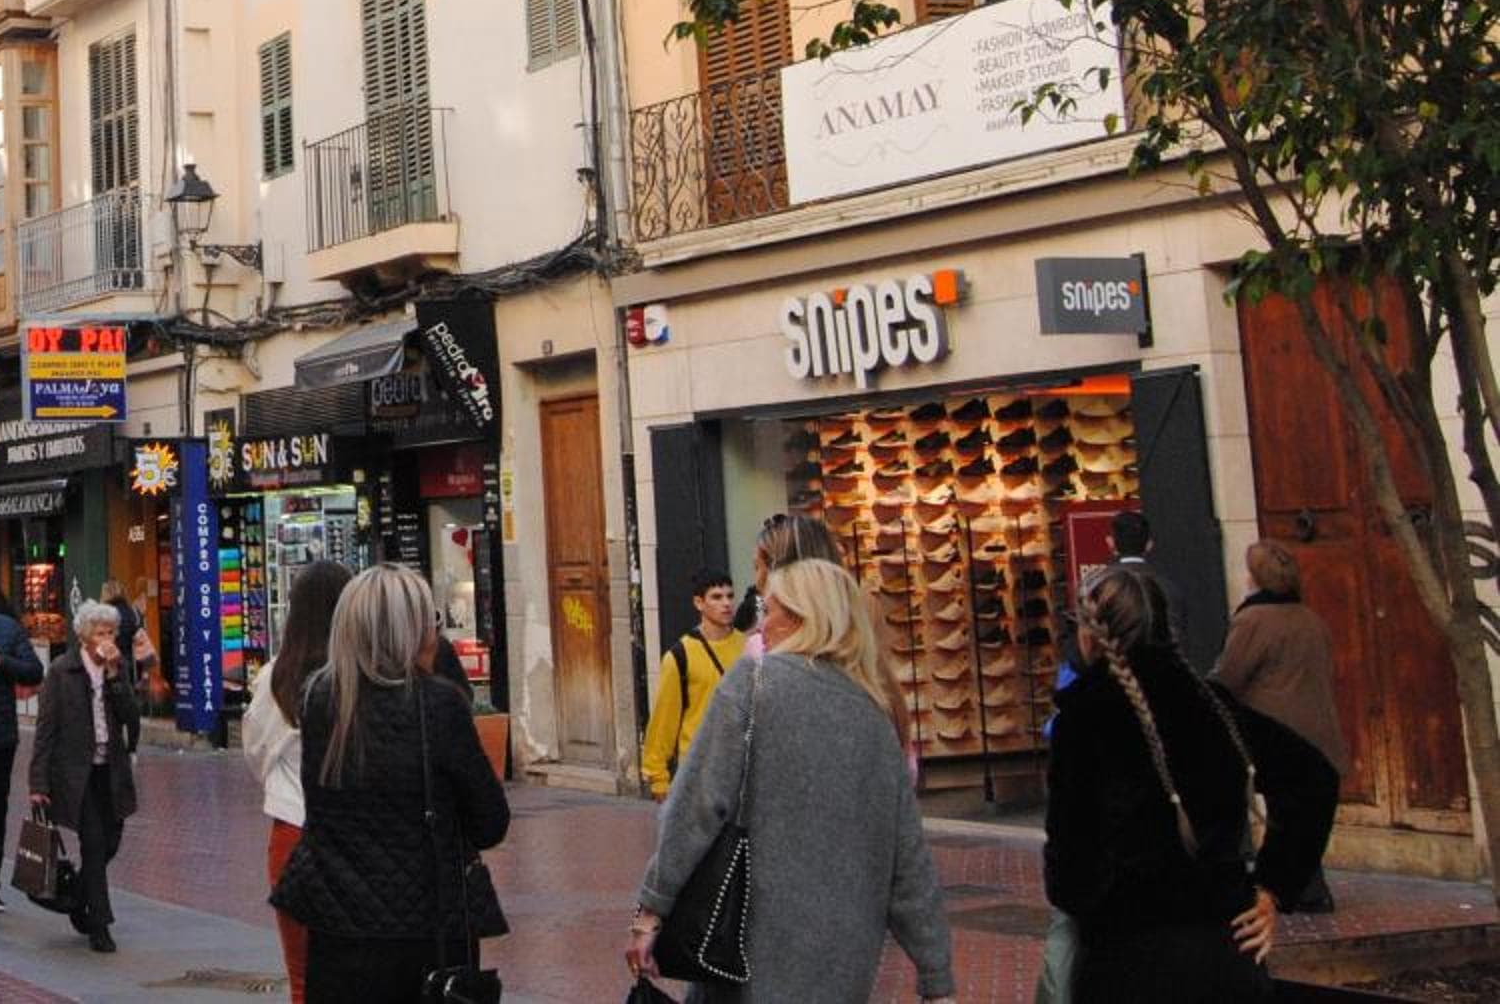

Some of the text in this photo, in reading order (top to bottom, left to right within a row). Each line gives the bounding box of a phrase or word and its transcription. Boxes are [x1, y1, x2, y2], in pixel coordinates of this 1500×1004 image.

[979, 50, 1020, 76] BEAUTY
[1029, 56, 1071, 81] STUDIO
[815, 80, 946, 139] ANAMAY
[1062, 280, 1131, 317] snipes
[782, 272, 940, 388] snipes
[241, 439, 276, 472] SUN
[290, 433, 329, 467] SUN
